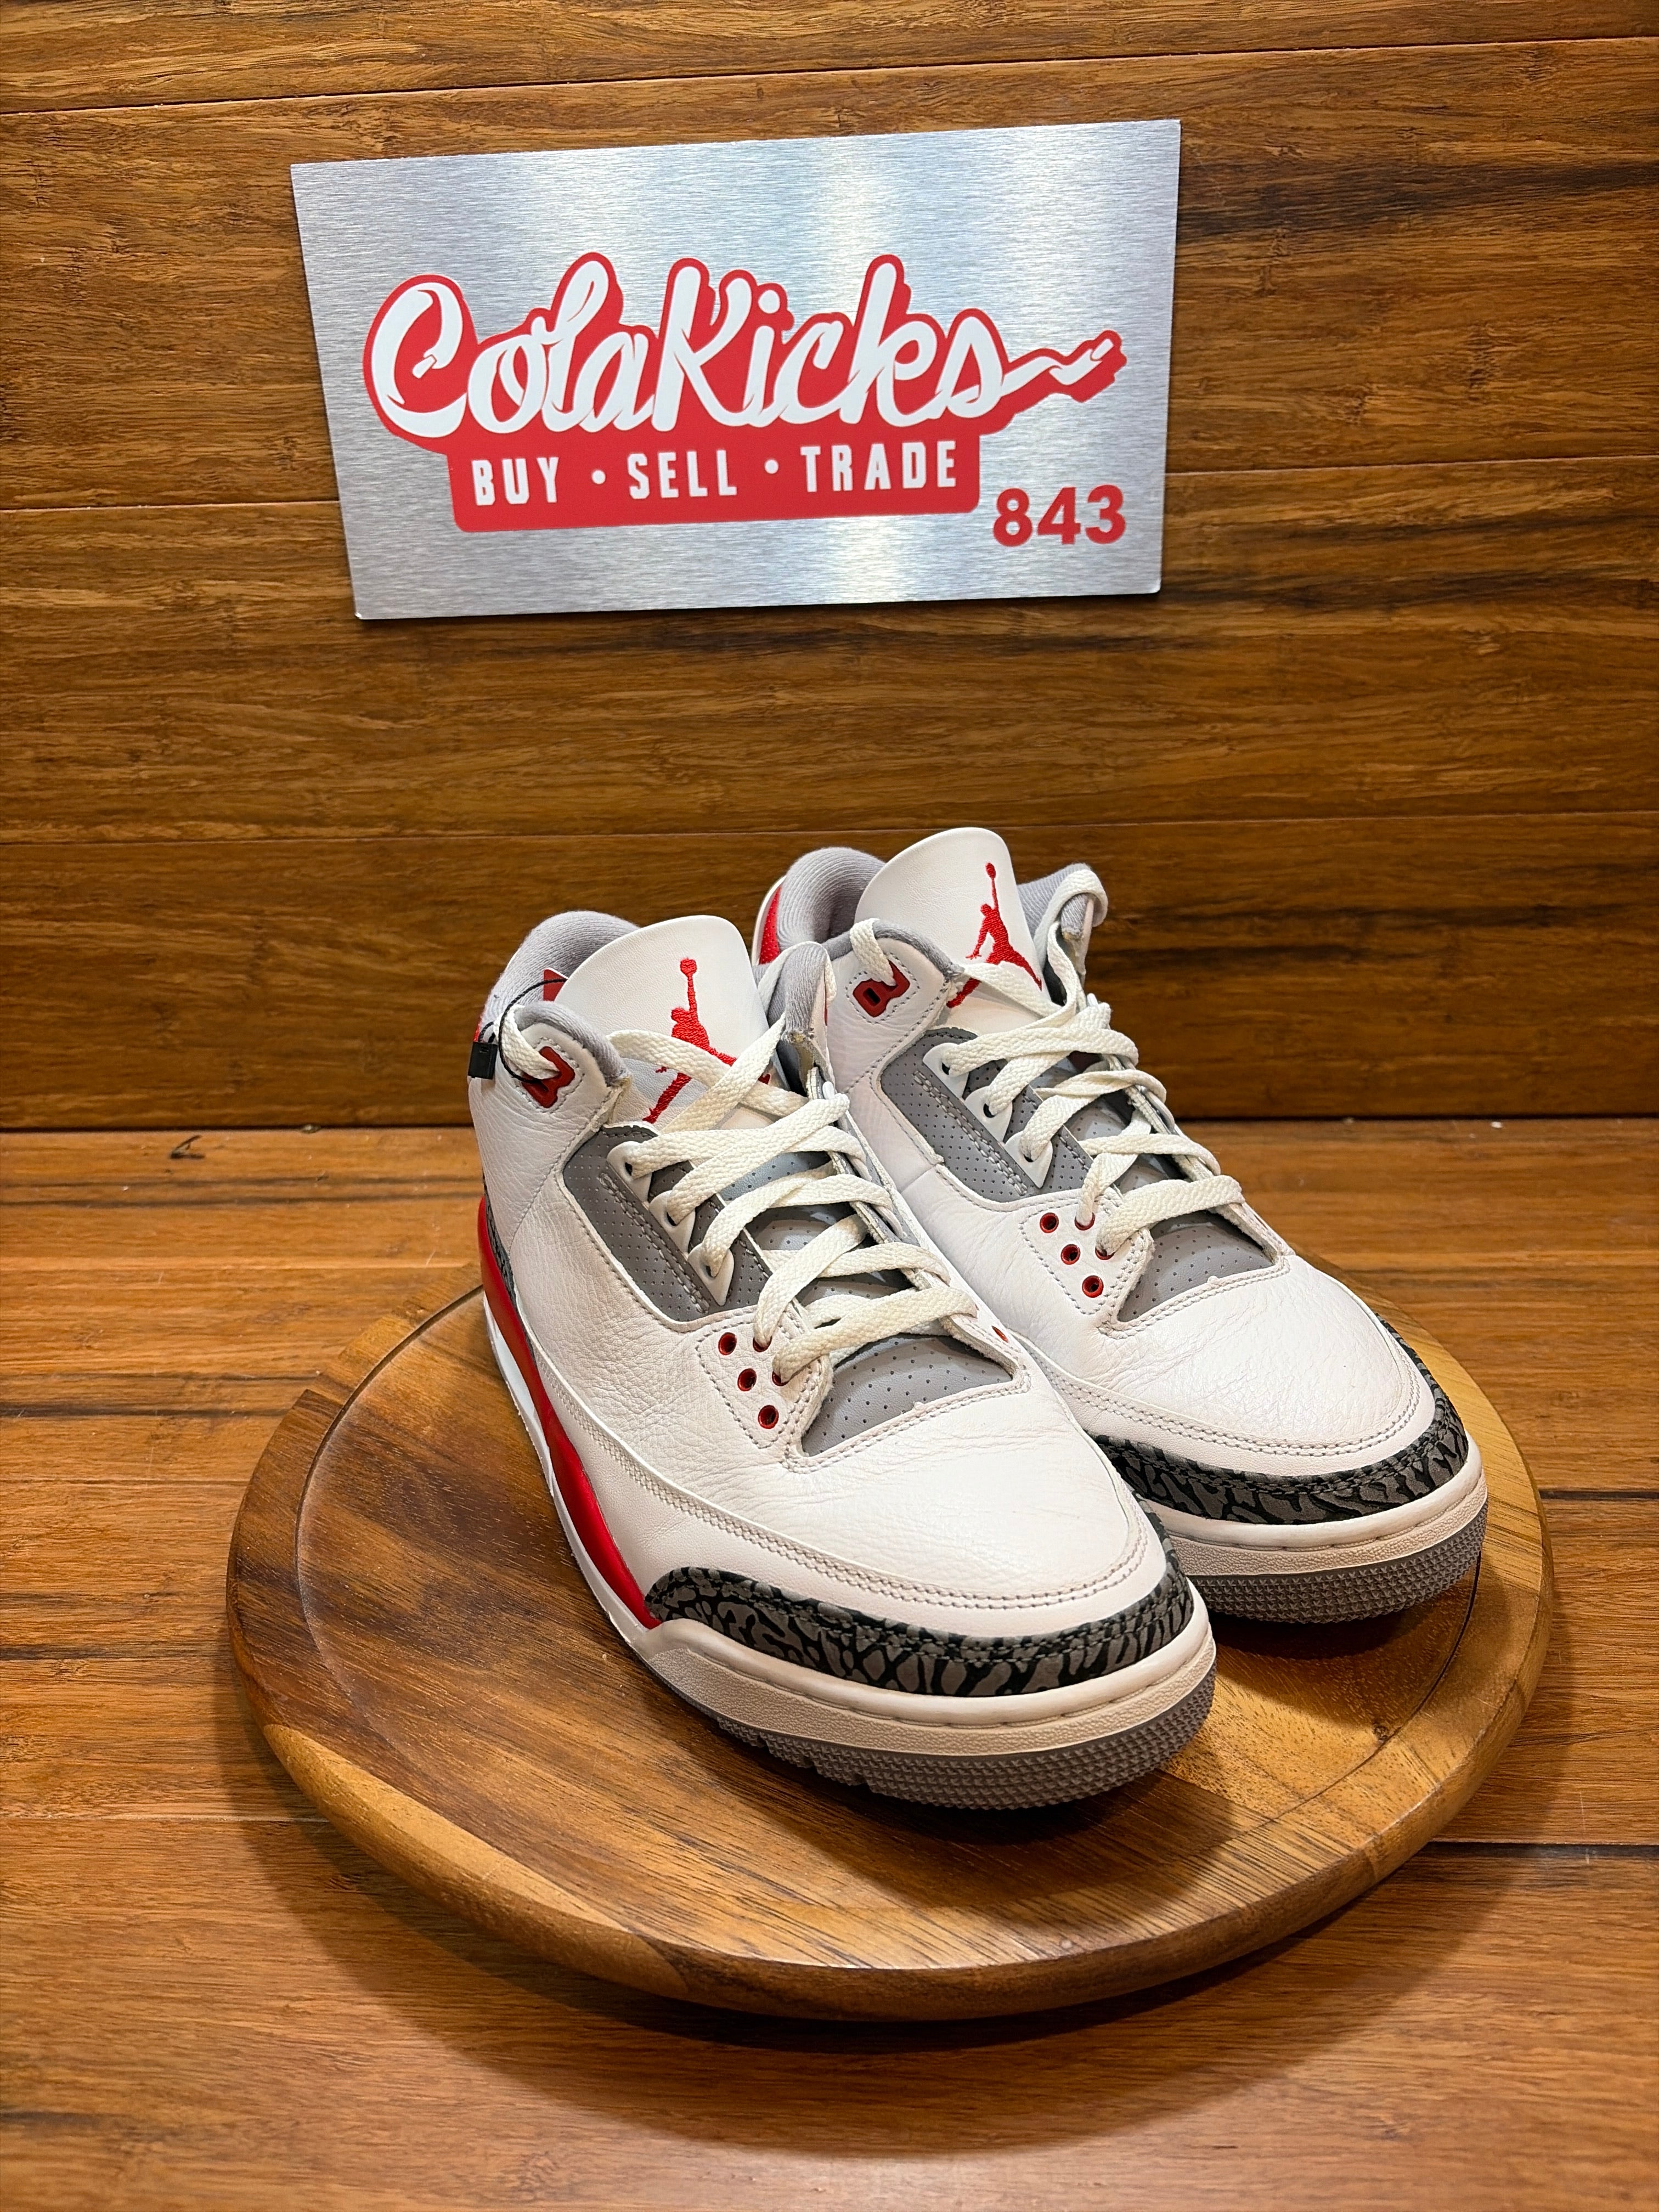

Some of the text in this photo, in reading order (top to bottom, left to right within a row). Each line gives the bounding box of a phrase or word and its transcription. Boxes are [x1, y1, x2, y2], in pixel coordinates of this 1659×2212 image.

[471, 439, 956, 506] BUY SELL TRADE
[992, 483, 1126, 547] 843
